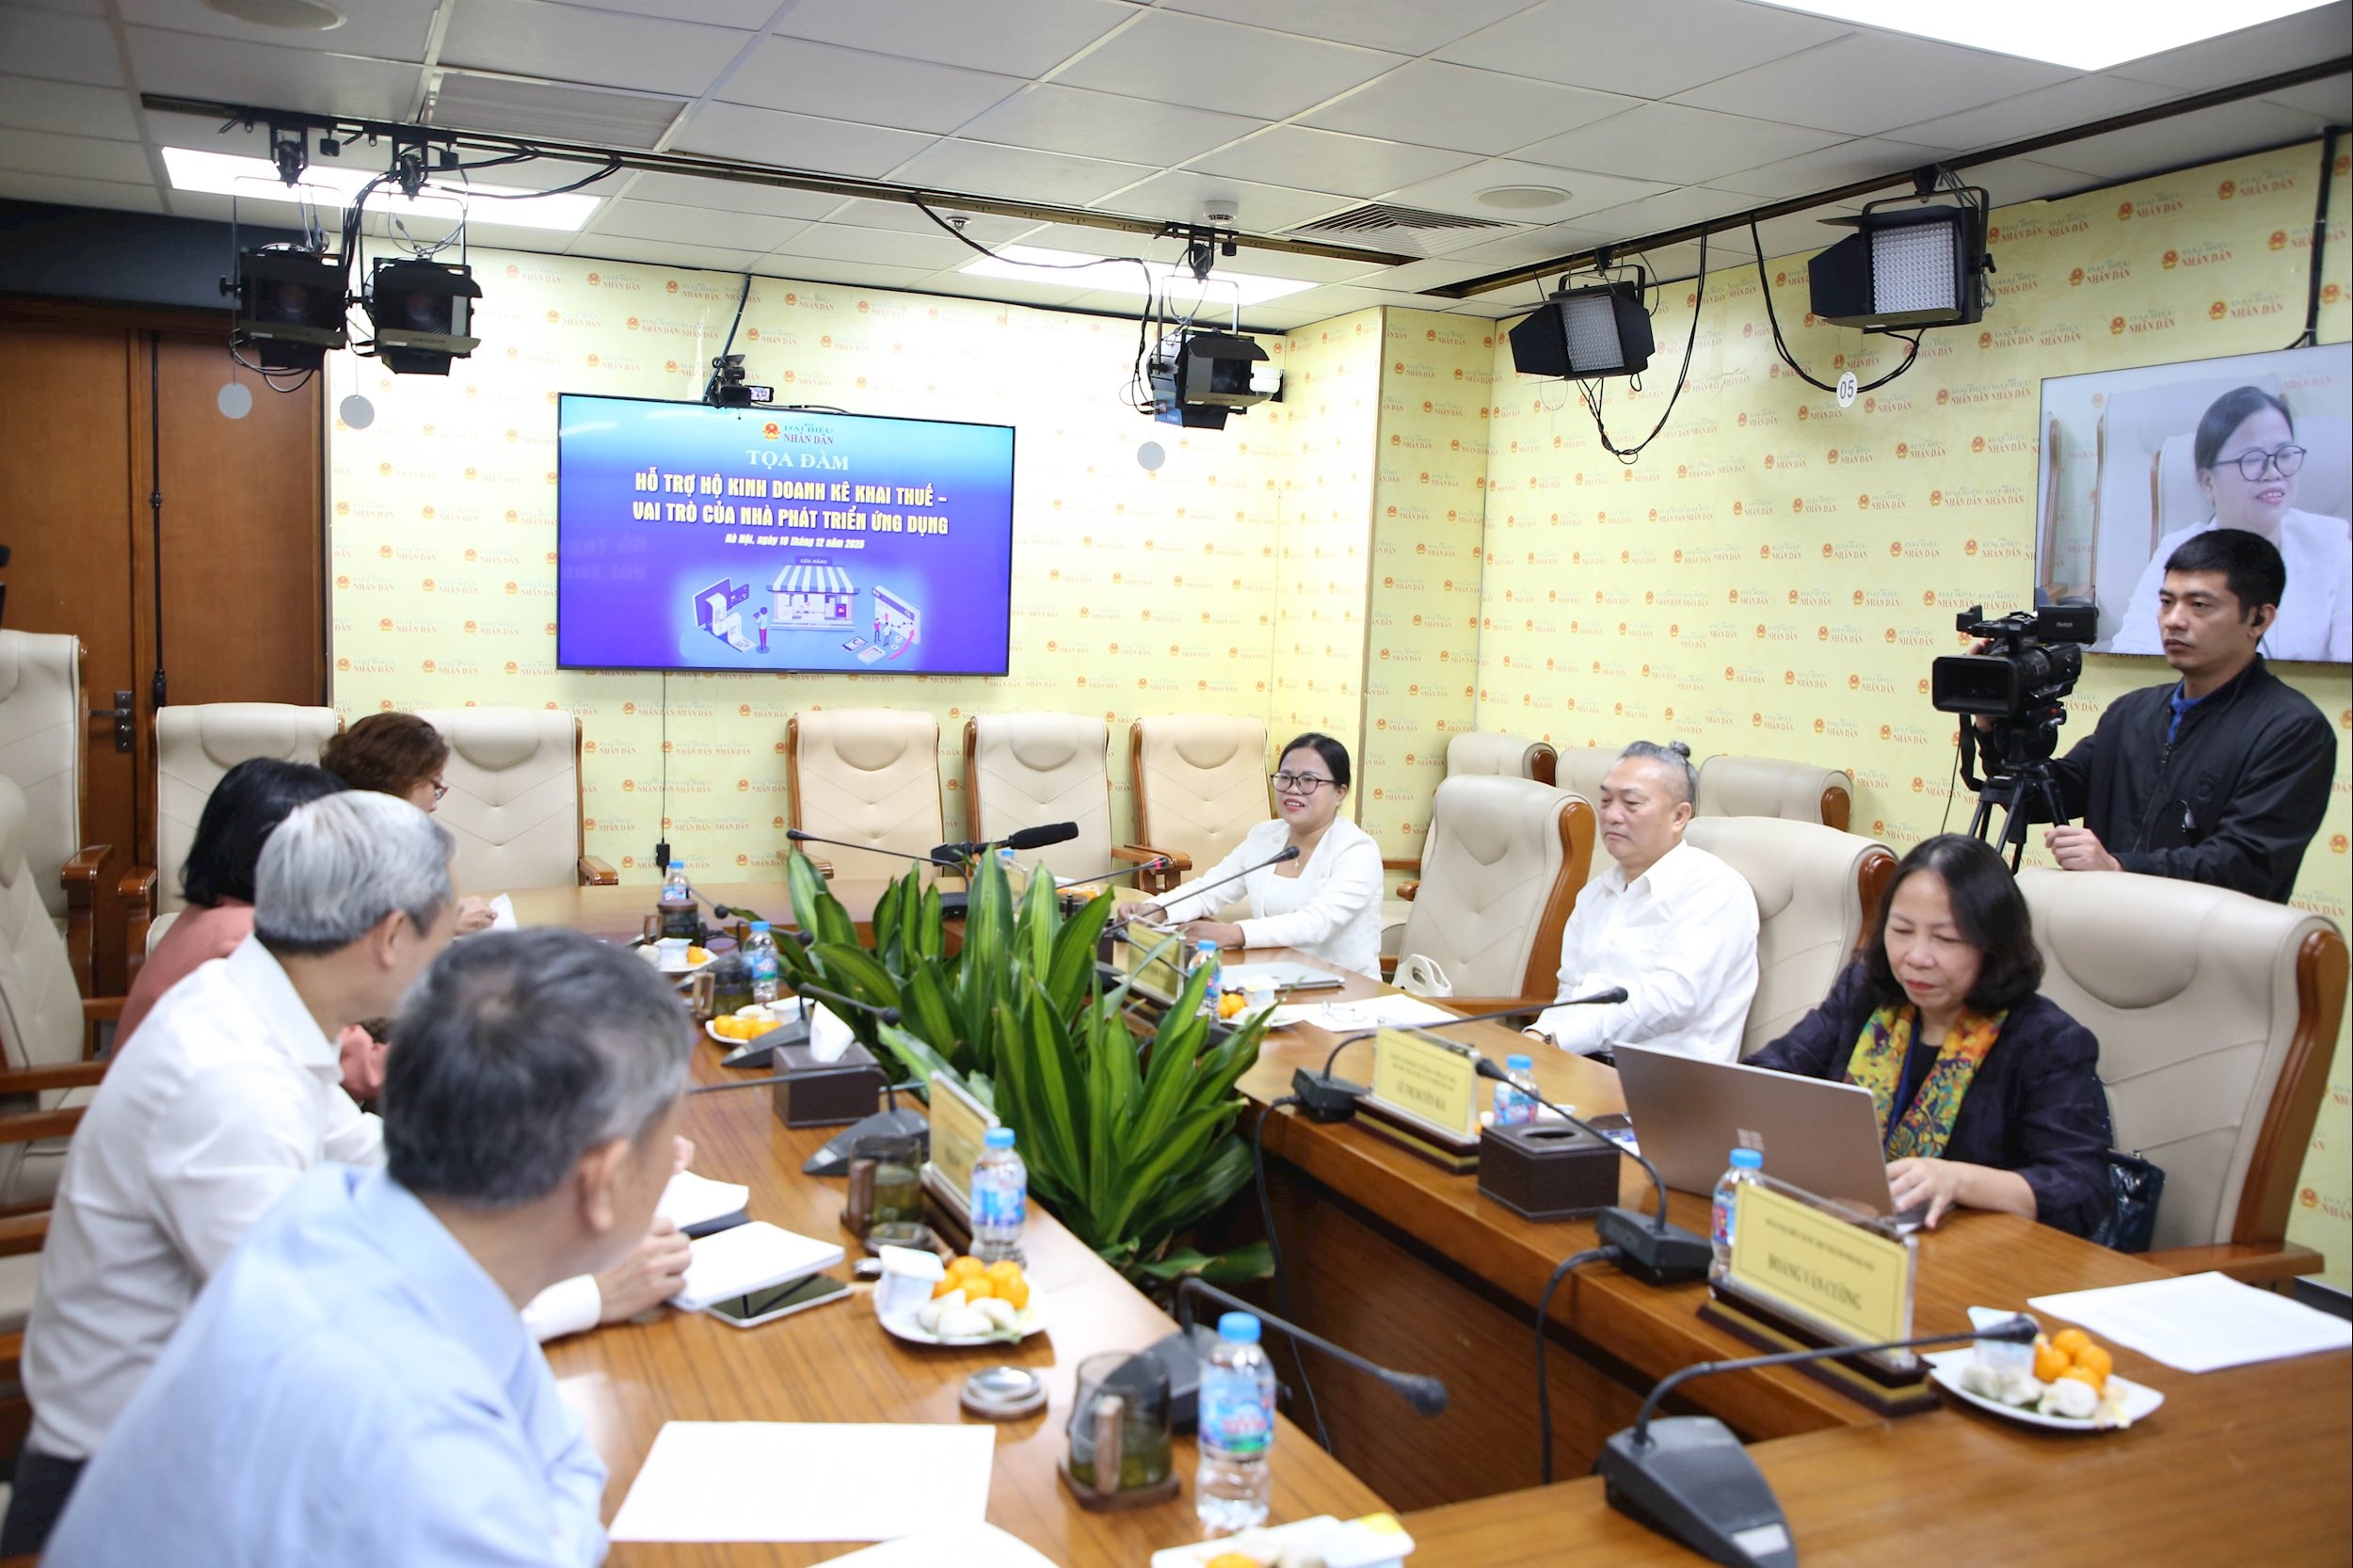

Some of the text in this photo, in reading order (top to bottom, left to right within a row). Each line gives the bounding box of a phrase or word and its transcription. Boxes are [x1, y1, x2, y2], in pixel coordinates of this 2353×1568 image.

[1840, 380, 1854, 399] 05
[784, 432, 834, 444] NHÂN DÂN
[746, 450, 849, 471] TỌA ĐÀM
[635, 467, 659, 492] HỖ
[664, 473, 696, 498] TRỢ
[700, 473, 723, 499] HỘ
[728, 477, 767, 498] KINH
[772, 480, 825, 501] DOANH
[830, 481, 851, 503] KÊ
[855, 486, 891, 504] KHAI
[896, 483, 934, 507] THUẾ
[632, 501, 949, 537] VAI TRÒ CỦA NHÀ PHÁT TRIỂN ỨNG DỤNG
[725, 534, 737, 543] Hà
[738, 535, 755, 546] Nội,
[757, 535, 778, 546] ngày
[791, 536, 814, 547] tháng
[816, 538, 824, 547] 12
[825, 538, 844, 548] năm
[844, 539, 865, 549] 2025
